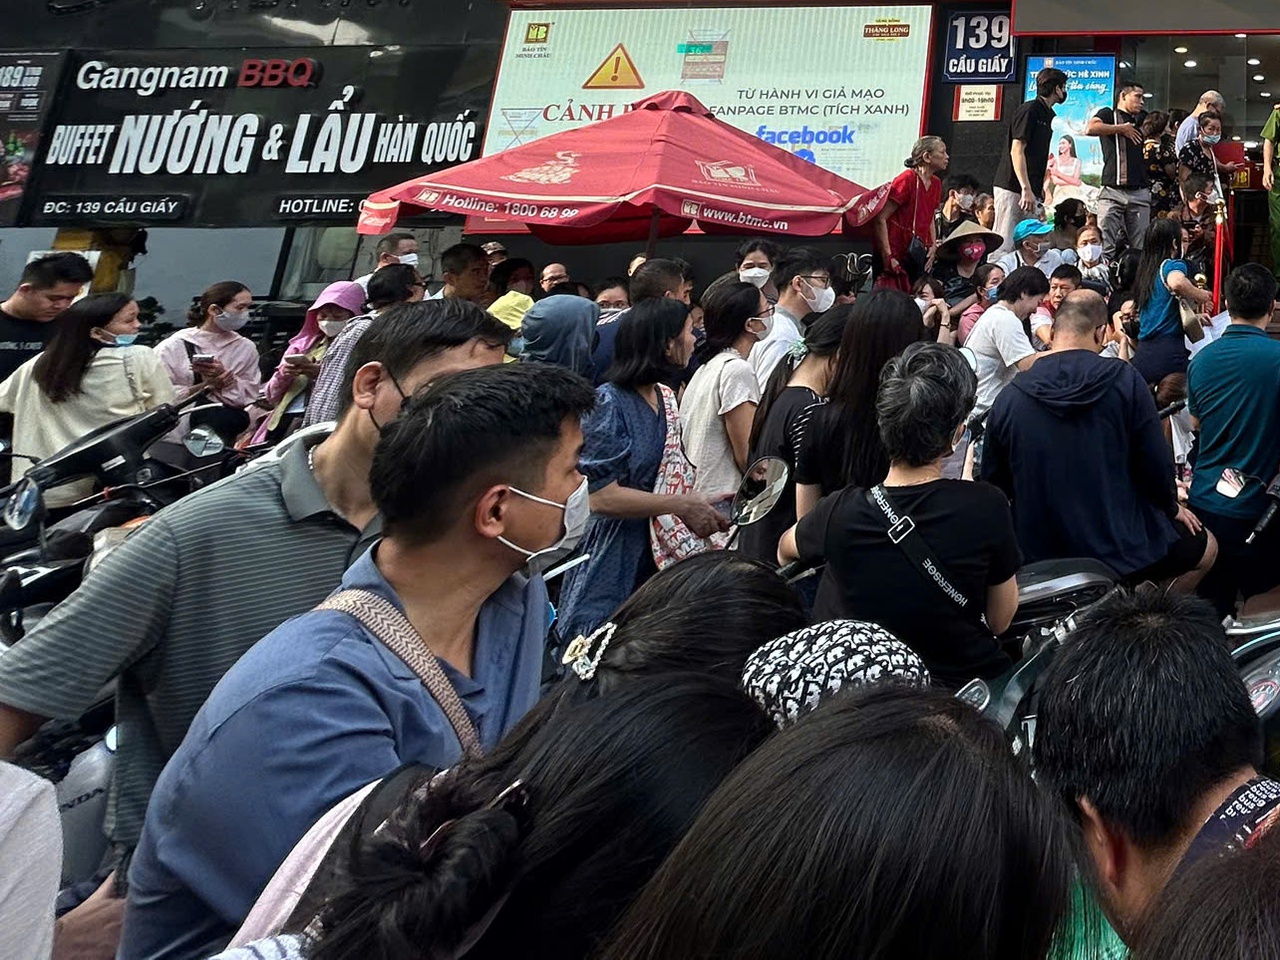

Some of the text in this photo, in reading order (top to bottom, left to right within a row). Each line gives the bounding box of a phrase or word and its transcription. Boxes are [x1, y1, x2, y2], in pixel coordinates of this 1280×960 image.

[952, 15, 1010, 49] 139
[948, 53, 1009, 73] CẦU GIẤY
[76, 60, 228, 96] Gangnam
[237, 57, 314, 87] BBQ
[737, 86, 885, 101] TỪ HÀNH VI GIẢ MẠO
[542, 98, 612, 121] CẢNH
[709, 103, 910, 117] FANPAGE BTMC (TÍCH XANH)
[45, 85, 476, 174] BUFFET NƯỚNG & LẨU HÀN QUỐC
[756, 125, 855, 144] facebook
[43, 193, 178, 214] ĐC: 139 CẦU GIẤY
[278, 199, 354, 213] HOTLINE:
[441, 193, 499, 212] Hotline:
[504, 202, 538, 217] 1800
[539, 207, 559, 218] 68
[703, 206, 788, 230] www.btmc.vn
